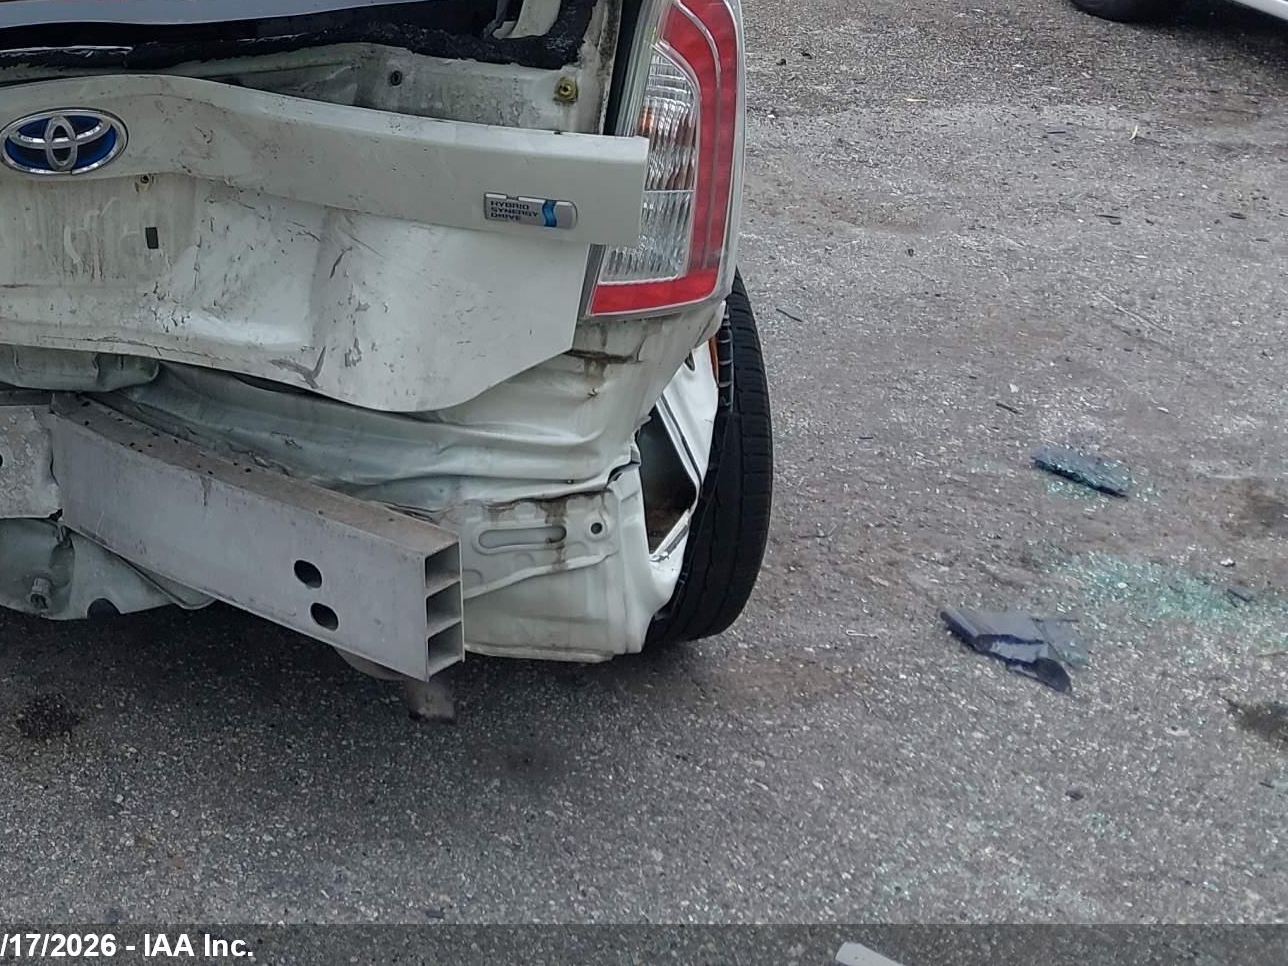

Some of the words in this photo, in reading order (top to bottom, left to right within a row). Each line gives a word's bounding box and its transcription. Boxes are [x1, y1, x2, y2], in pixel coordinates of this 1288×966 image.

[490, 200, 530, 211] HYBRID
[490, 206, 539, 218] SYNERGY
[490, 212, 522, 221] DRIVE
